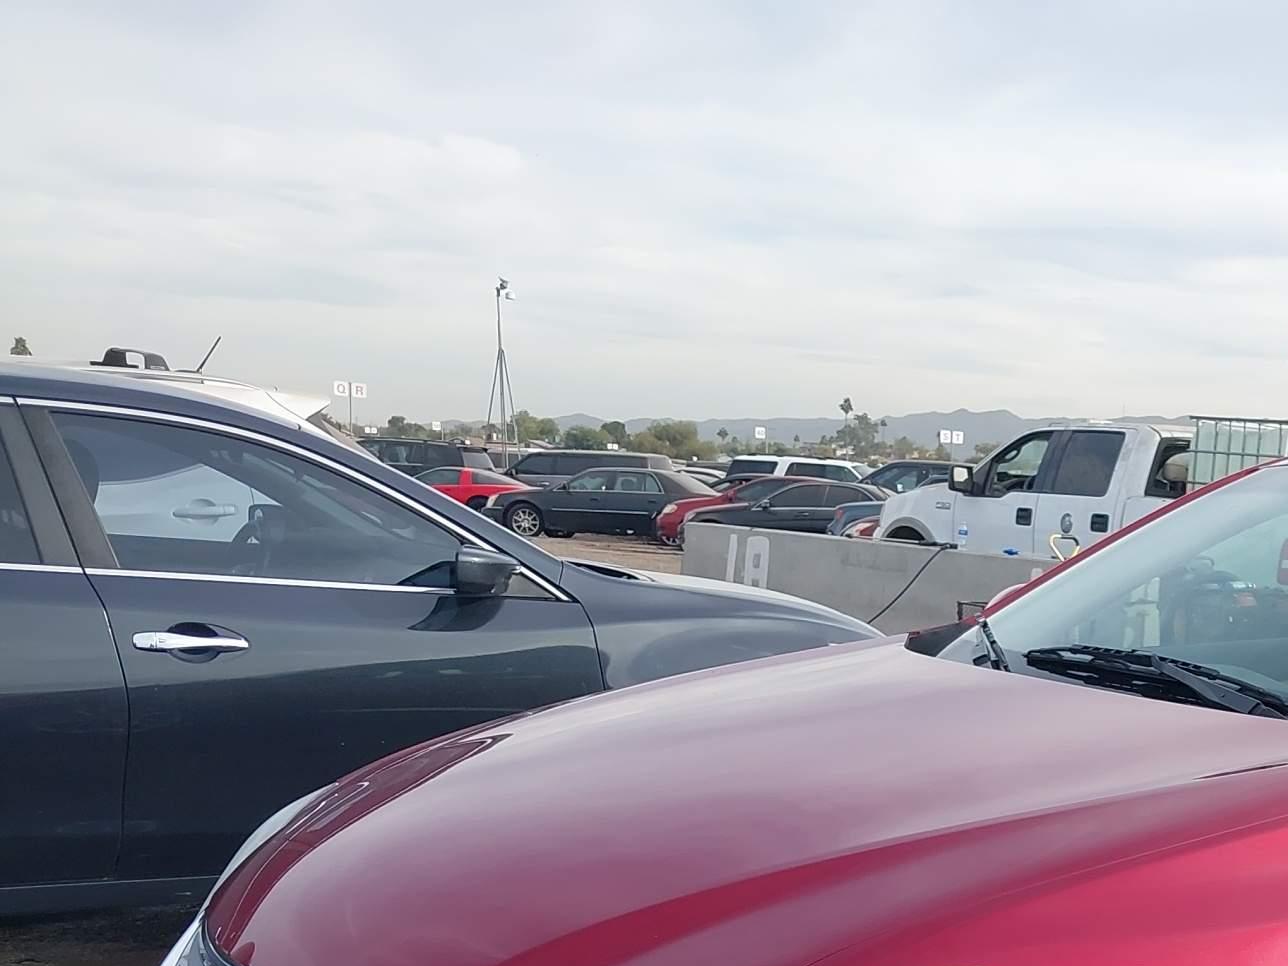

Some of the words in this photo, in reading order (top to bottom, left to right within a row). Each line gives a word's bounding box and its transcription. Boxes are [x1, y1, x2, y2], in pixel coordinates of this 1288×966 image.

[336, 383, 347, 394] Q
[355, 385, 364, 396] R
[943, 432, 950, 441] S
